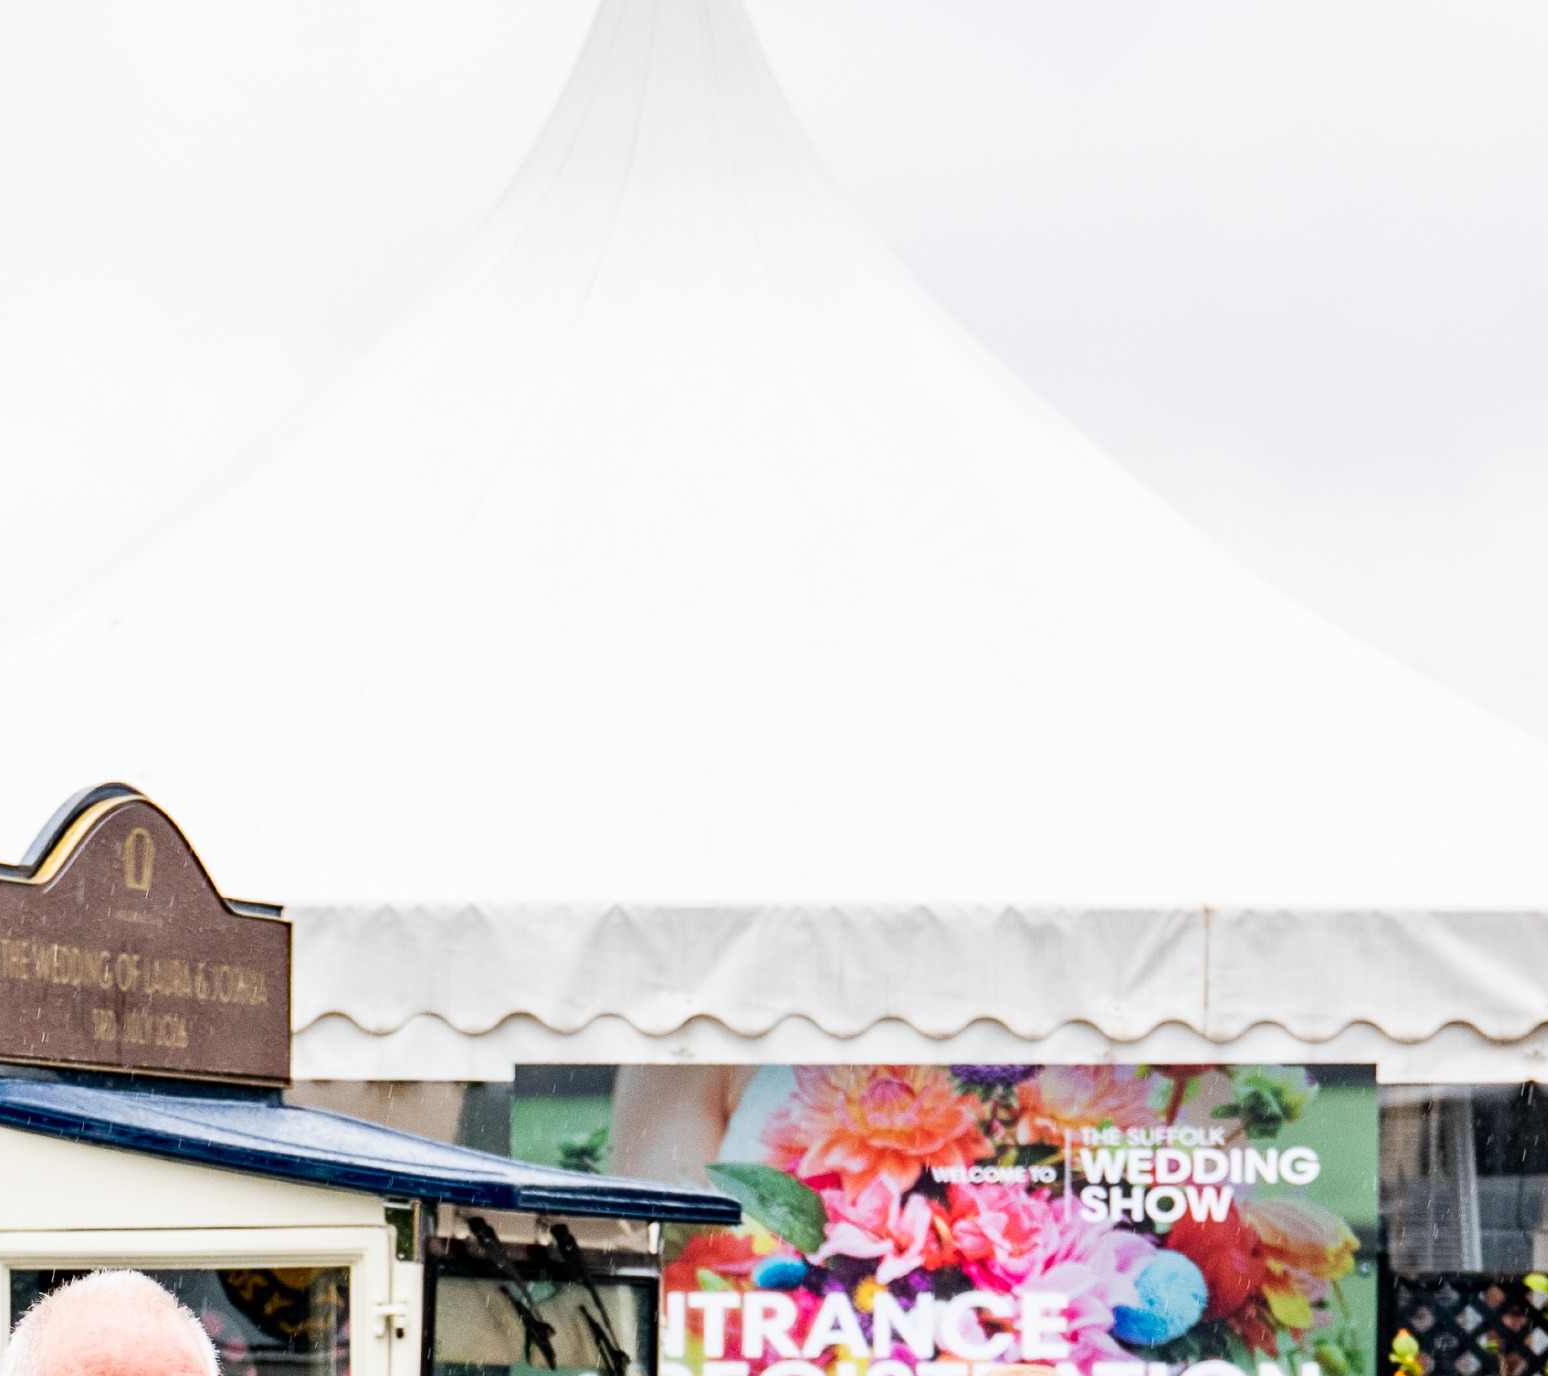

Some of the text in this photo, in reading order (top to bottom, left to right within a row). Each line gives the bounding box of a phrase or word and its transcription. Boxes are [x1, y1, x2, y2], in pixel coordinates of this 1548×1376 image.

[1081, 1126, 1226, 1147] THE SUFFOLK
[931, 1165, 1057, 1184] WELCOME TO
[1080, 1147, 1320, 1185] WEDDING
[1080, 1185, 1235, 1223] SHOW
[663, 1290, 1069, 1360] TRANCE
